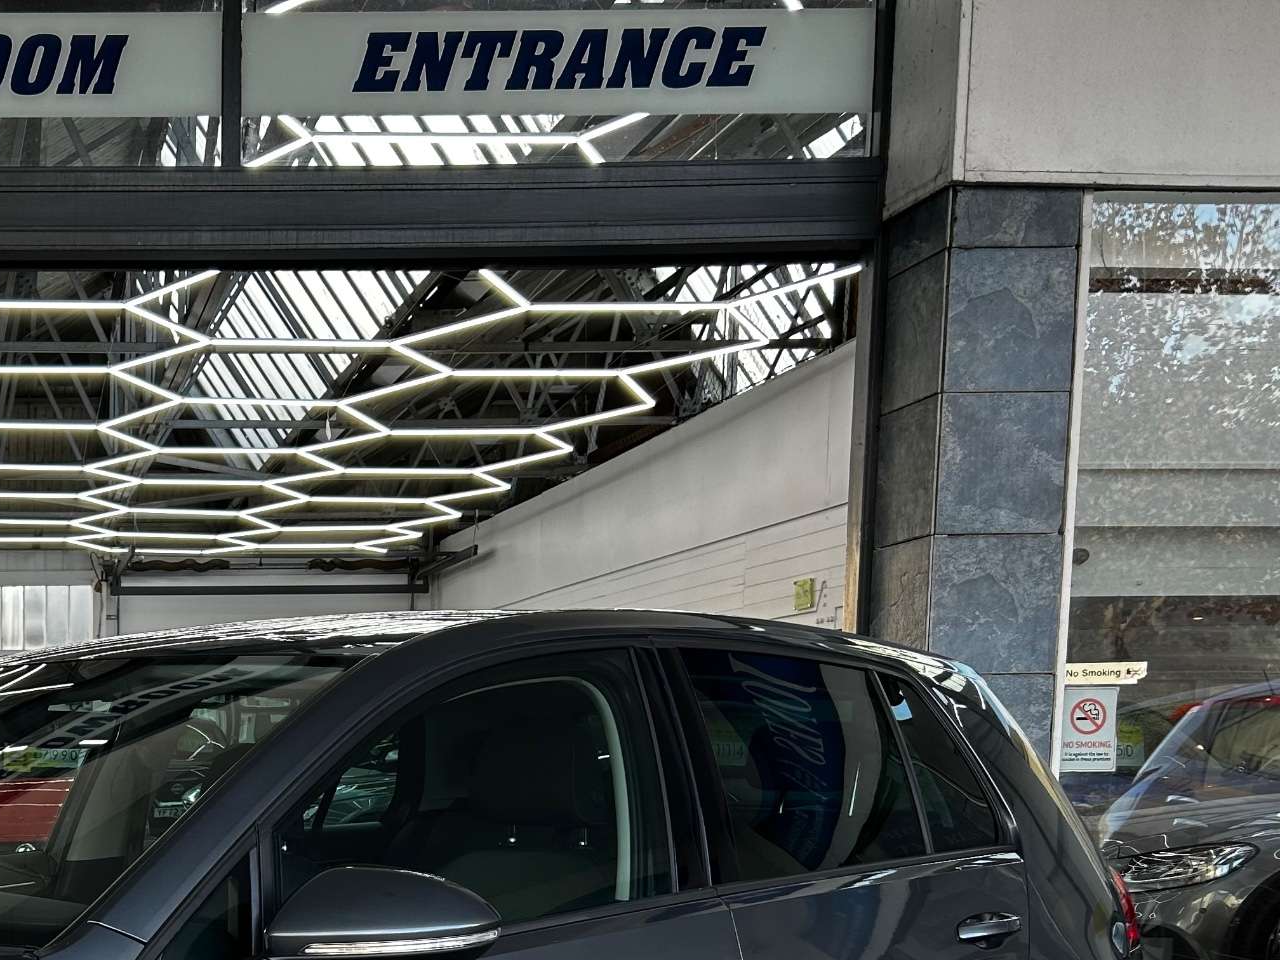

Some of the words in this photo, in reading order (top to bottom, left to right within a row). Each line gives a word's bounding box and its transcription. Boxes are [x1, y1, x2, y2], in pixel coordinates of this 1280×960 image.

[351, 26, 767, 93] ENTRANCE
[1065, 669, 1078, 678] No
[1082, 669, 1121, 678] Smoking
